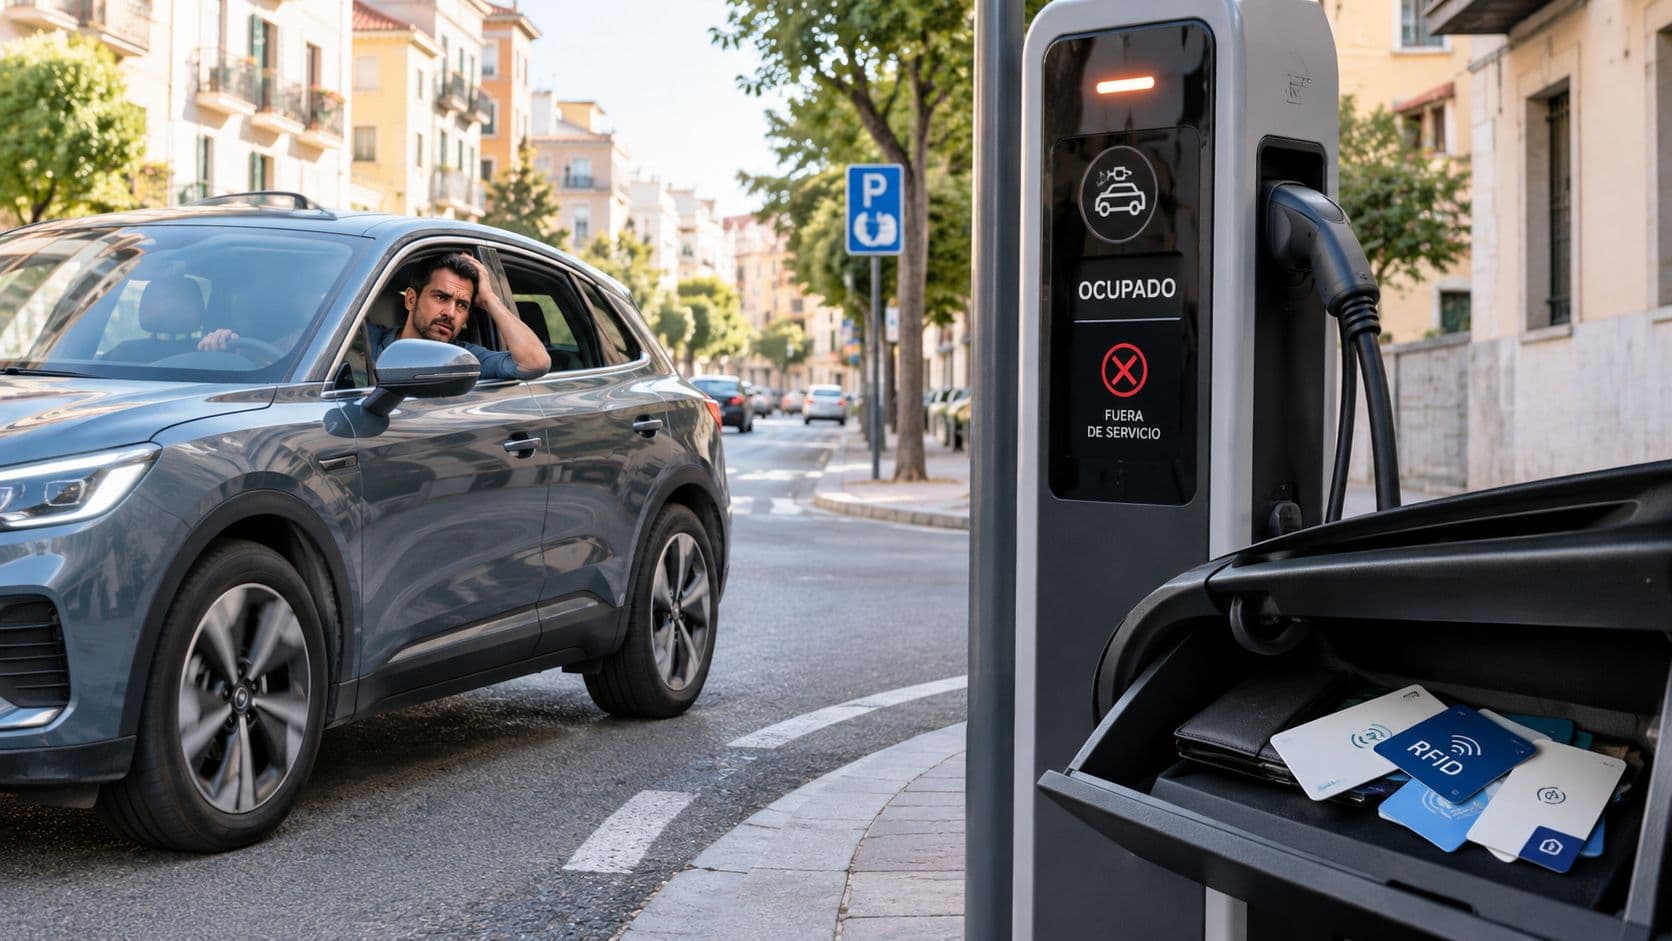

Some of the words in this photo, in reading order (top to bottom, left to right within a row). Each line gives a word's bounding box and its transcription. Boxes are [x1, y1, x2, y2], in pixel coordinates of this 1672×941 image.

[863, 173, 887, 208] P
[1078, 277, 1176, 300] OCUPADO
[1105, 409, 1144, 422] FUERA
[1087, 425, 1103, 438] DE
[1105, 426, 1161, 440] SERVICIO
[1407, 740, 1463, 775] RFID
